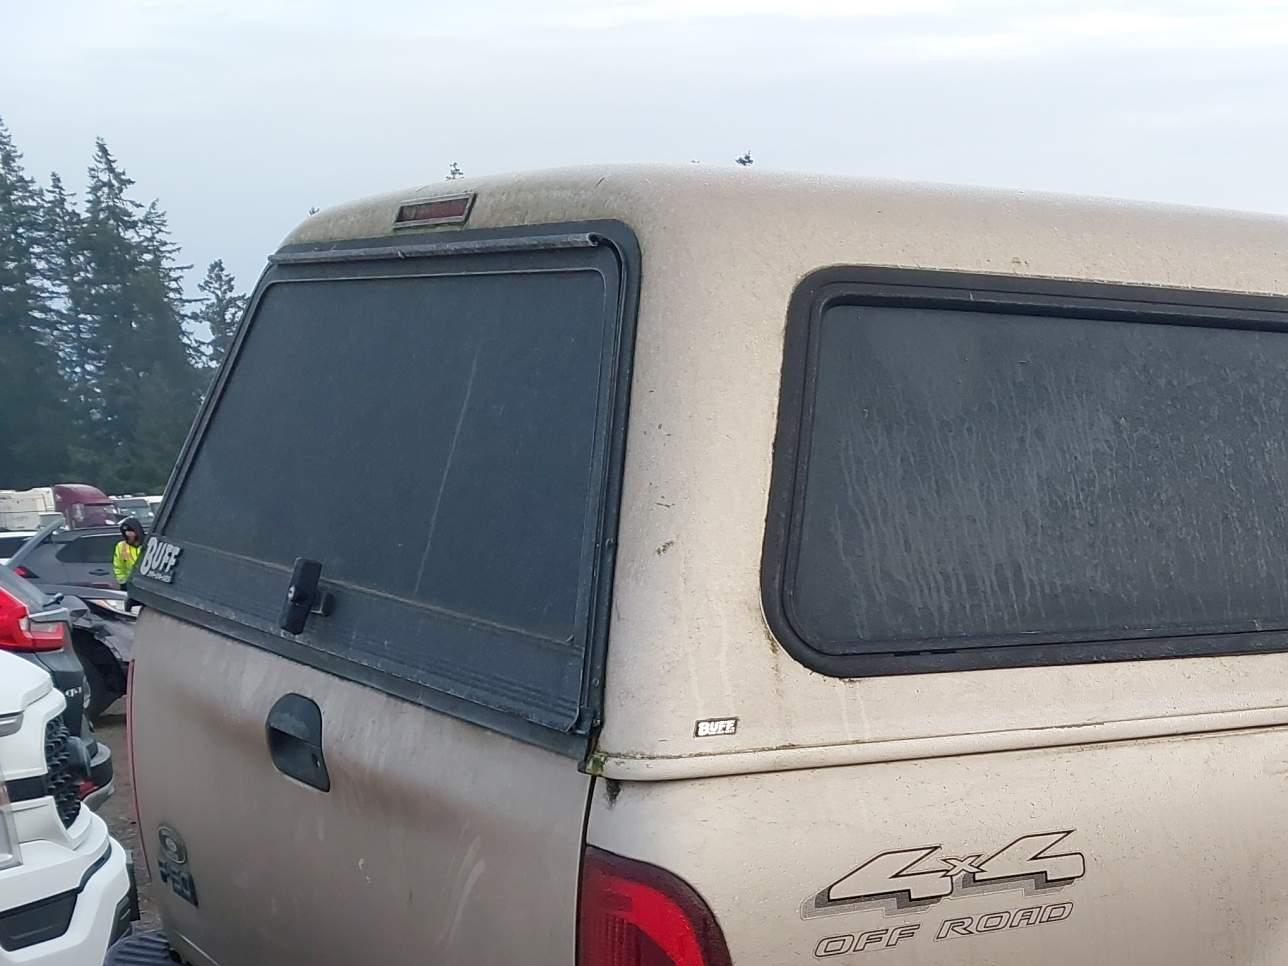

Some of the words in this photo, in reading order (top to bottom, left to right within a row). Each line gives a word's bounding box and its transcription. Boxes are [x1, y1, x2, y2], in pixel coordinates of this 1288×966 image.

[140, 536, 181, 576] BUFF
[698, 719, 736, 737] BUFF
[813, 923, 921, 958] OFF
[935, 902, 1074, 940] ROAD
